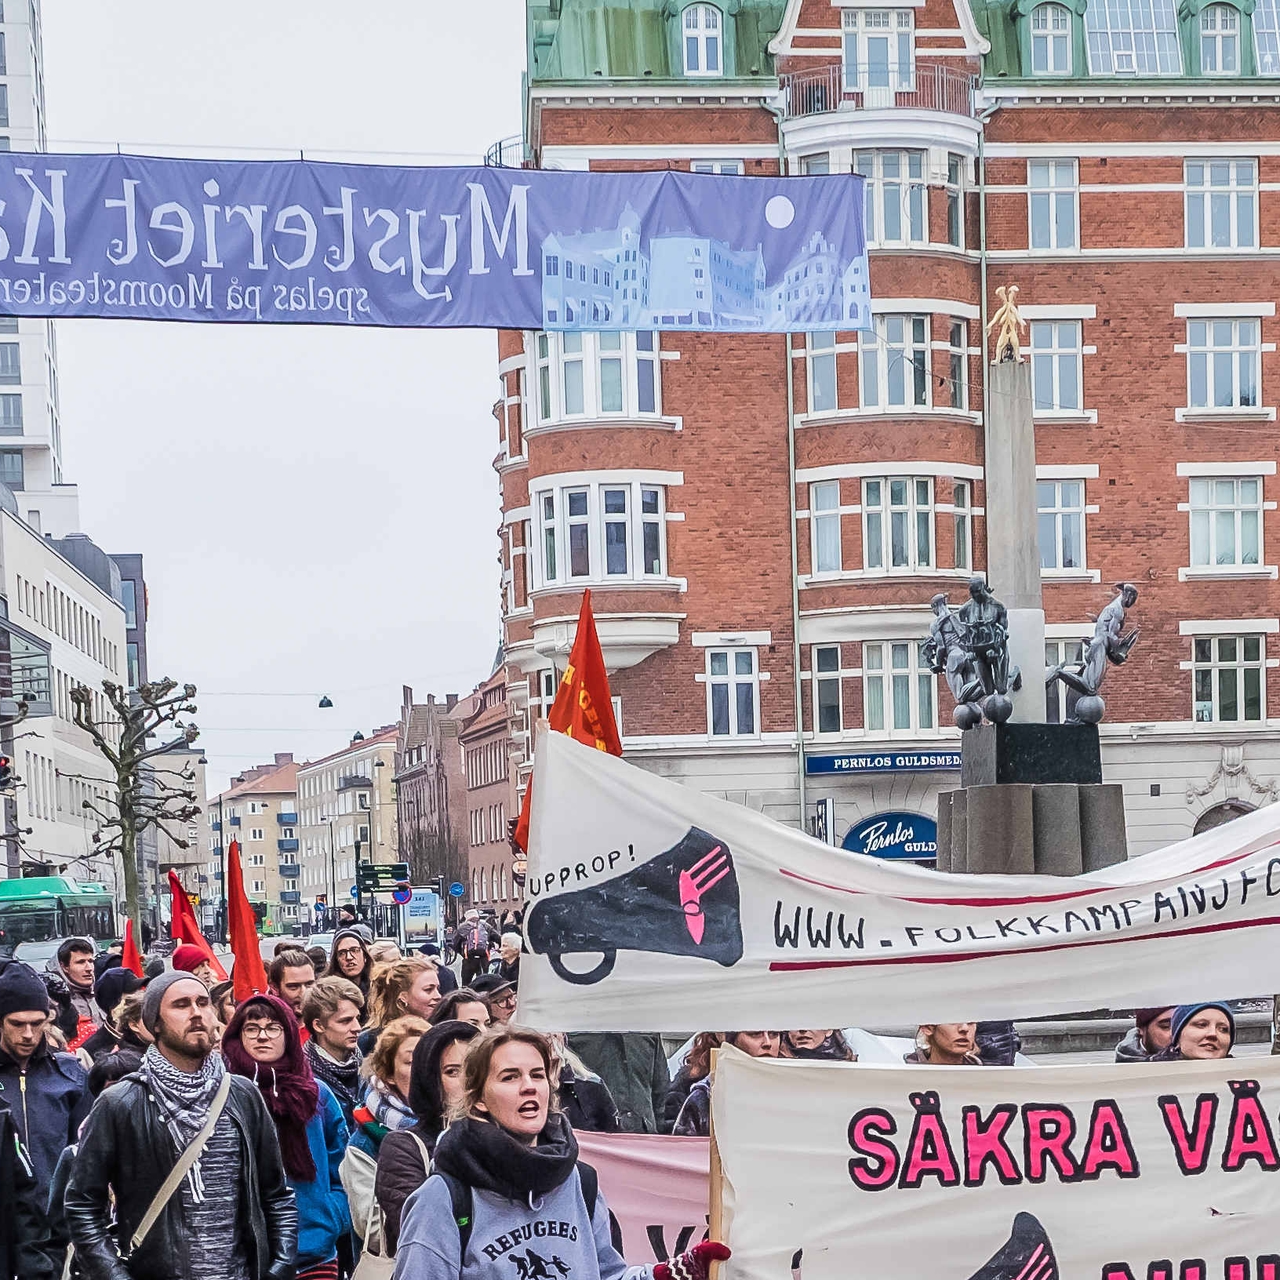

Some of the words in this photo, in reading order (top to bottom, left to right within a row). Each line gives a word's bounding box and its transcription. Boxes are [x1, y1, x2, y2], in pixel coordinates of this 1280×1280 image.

[834, 757, 892, 769] PERNLOS
[895, 755, 963, 767] GULDSMED
[859, 821, 914, 854] Pernlos
[904, 842, 938, 852] GULD
[529, 843, 636, 897] UPPROP!
[847, 1090, 1139, 1192] SÄKRA
[481, 1220, 578, 1261] REFUGEES
